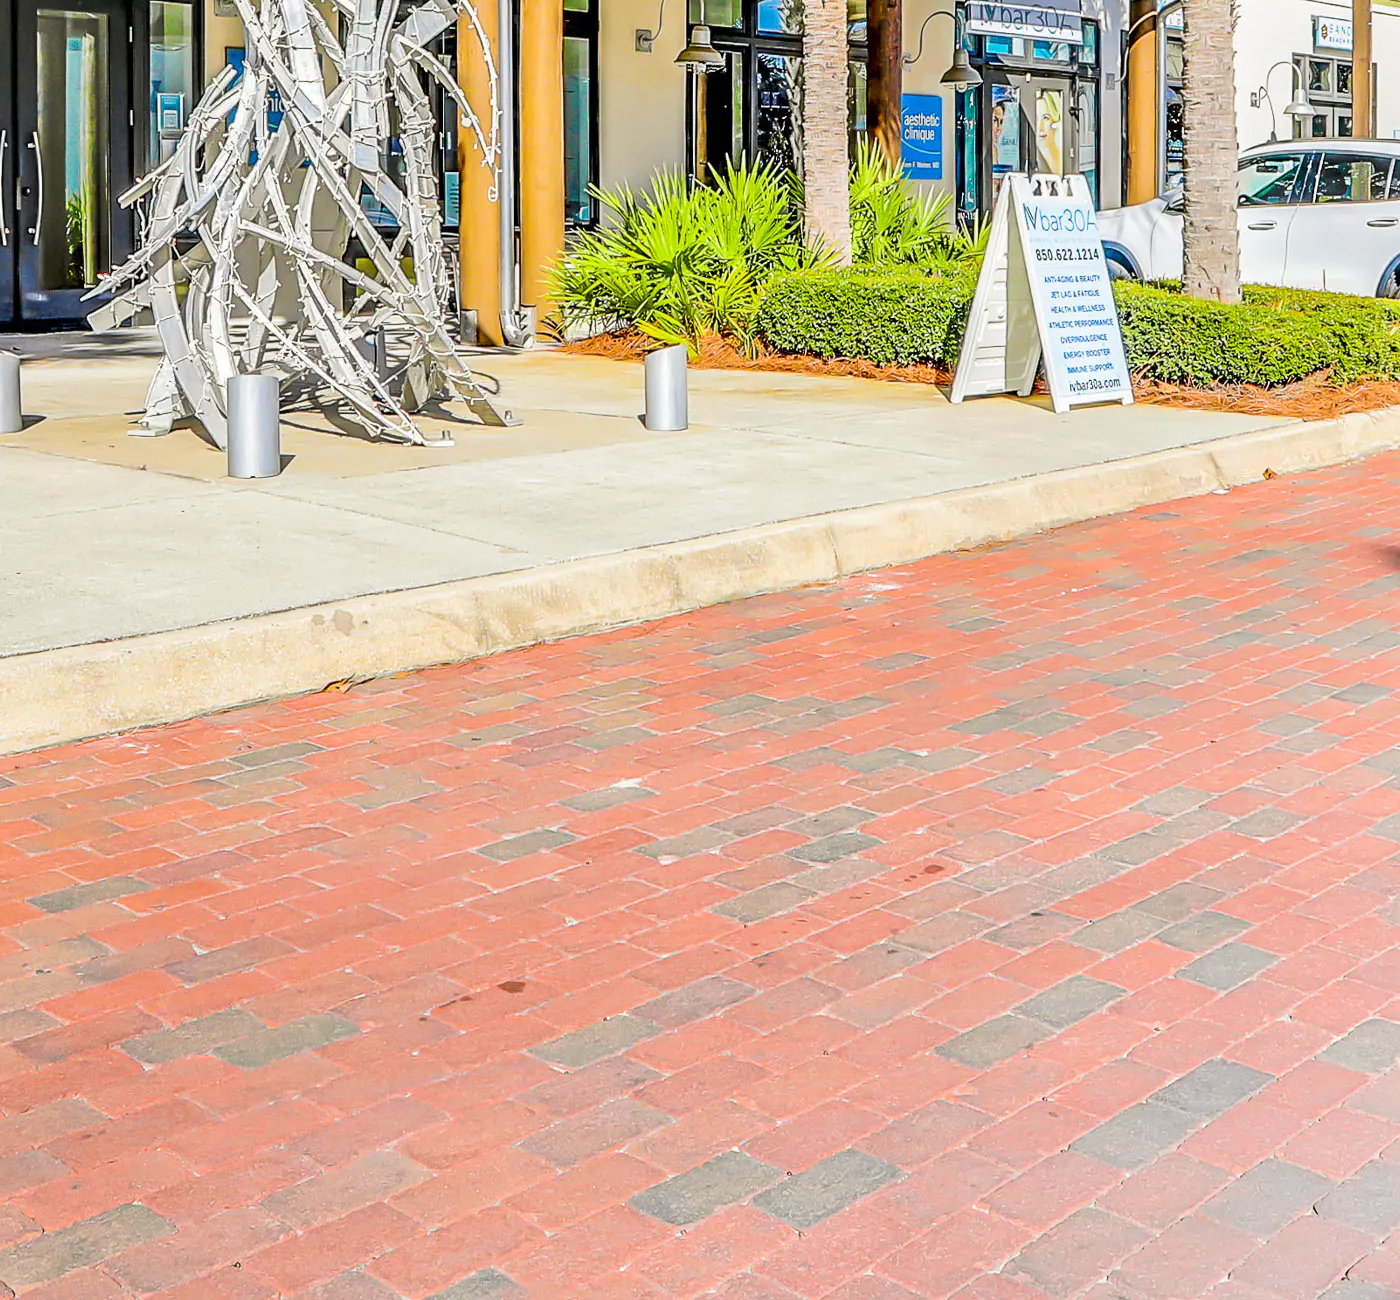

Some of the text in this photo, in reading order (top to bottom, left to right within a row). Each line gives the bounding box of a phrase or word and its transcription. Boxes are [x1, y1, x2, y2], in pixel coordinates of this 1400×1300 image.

[903, 112, 940, 127] aesthetic
[904, 126, 935, 144] clinique
[1035, 248, 1100, 261] 850.622.1214
[1044, 275, 1074, 283] ANTI-AGING
[1080, 274, 1100, 282] BEAUTY
[1050, 291, 1059, 299] JET
[1060, 290, 1072, 298] LAG
[1077, 289, 1100, 297] FATIGUE
[1050, 305, 1072, 314] HEALTH
[1077, 304, 1106, 313] WELLNESS
[1049, 318, 1114, 329] ATHLETIC PERFORMANCE
[1060, 333, 1108, 344] OVERINDULGENCE
[1063, 348, 1111, 359] ENERGY BOOSTER
[1067, 363, 1114, 374] IMMUNE SUPPORT
[1069, 378, 1121, 392] ivbar30a.com
